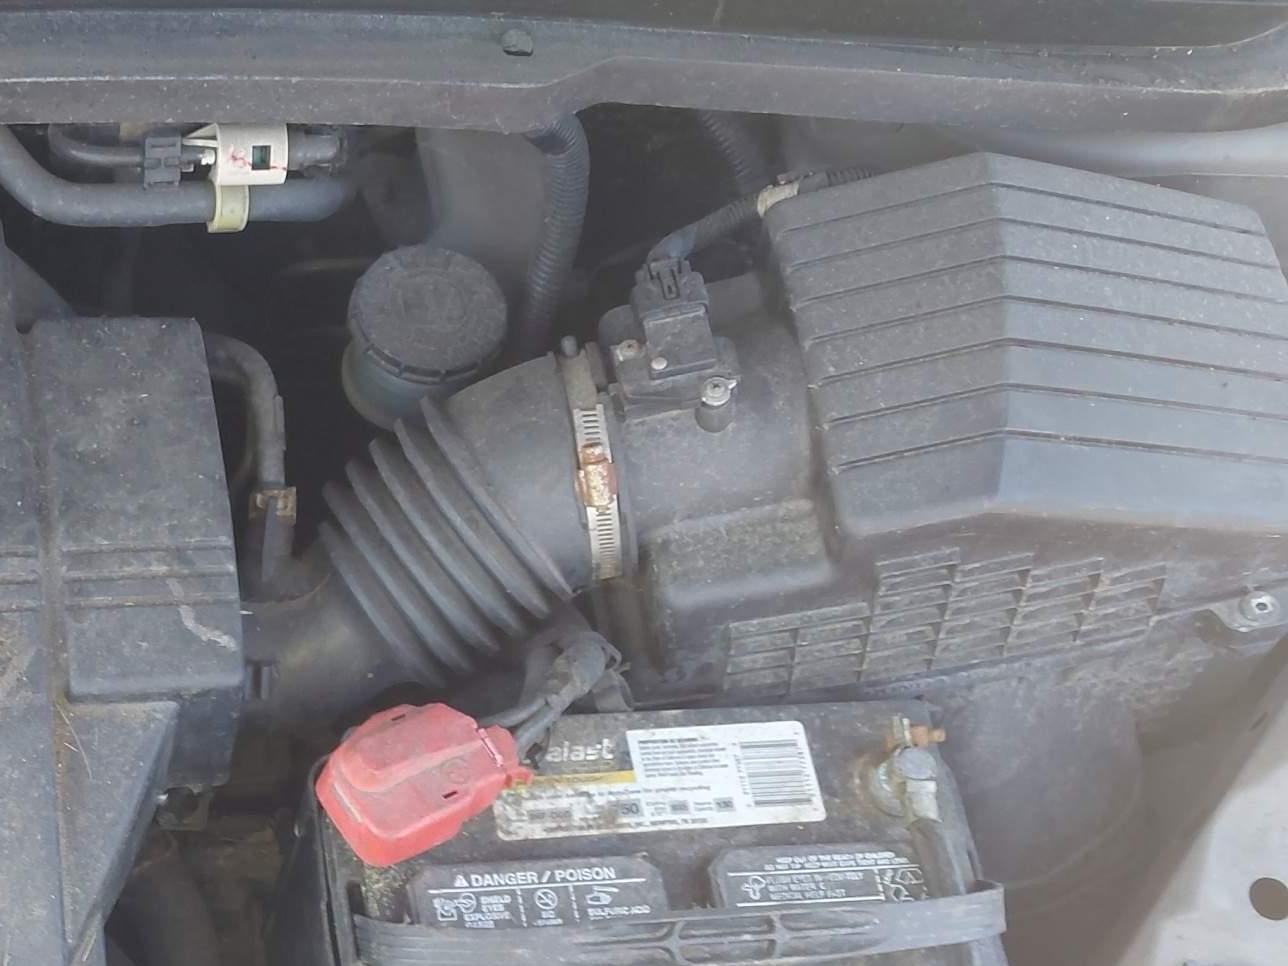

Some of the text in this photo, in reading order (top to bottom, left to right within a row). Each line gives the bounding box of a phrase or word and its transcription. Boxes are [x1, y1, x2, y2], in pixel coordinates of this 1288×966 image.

[470, 866, 616, 888] DANGER / POISON
